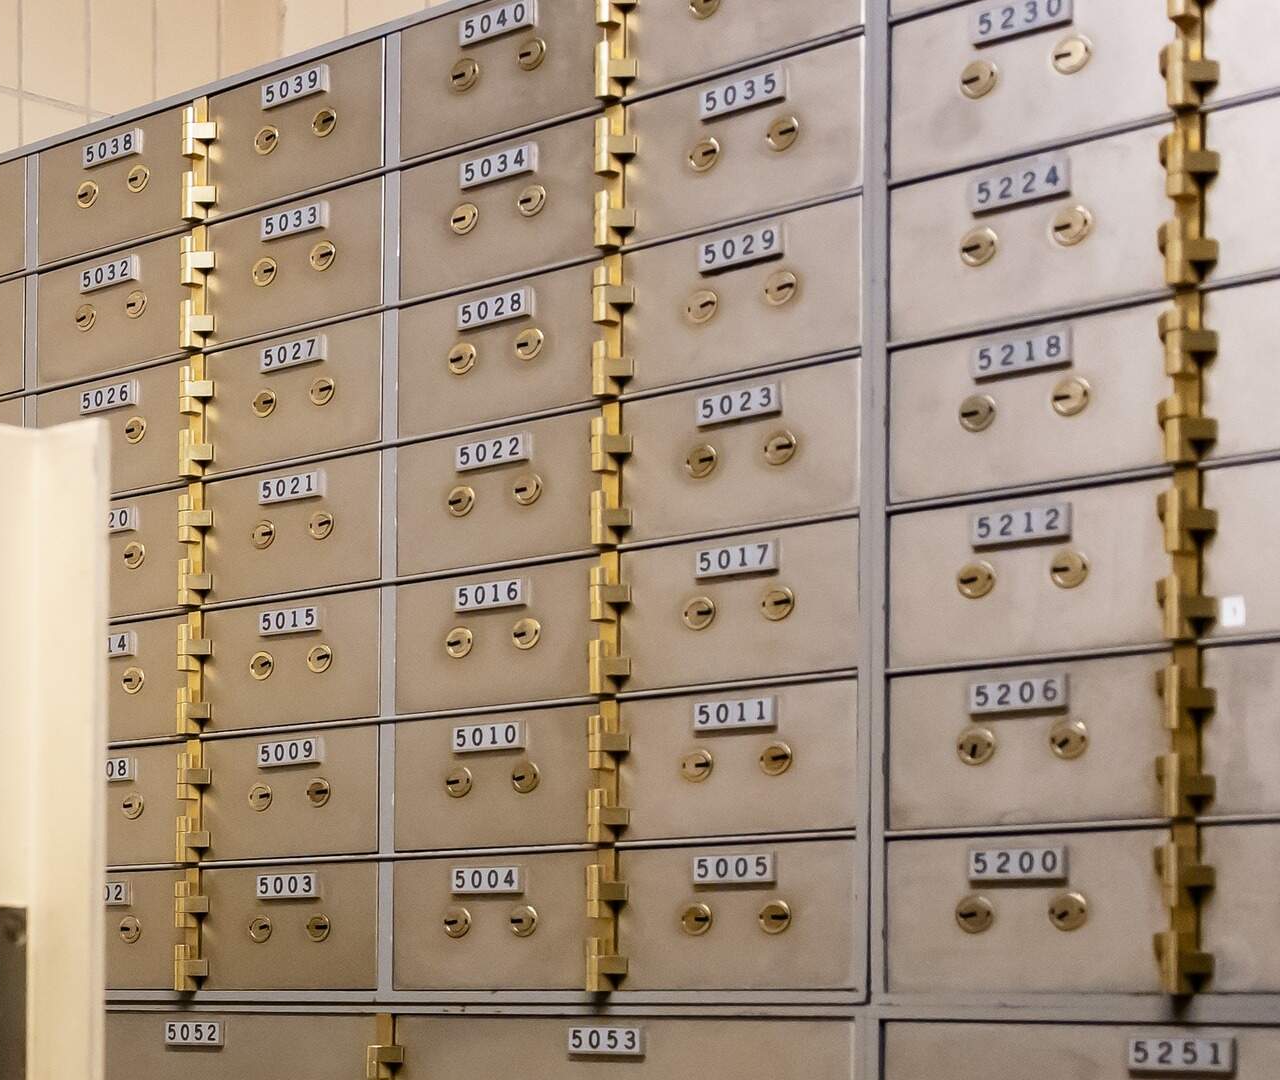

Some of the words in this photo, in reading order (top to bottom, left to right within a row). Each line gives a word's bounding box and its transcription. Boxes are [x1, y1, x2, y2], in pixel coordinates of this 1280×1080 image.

[465, 3, 525, 38] 5040
[979, 0, 1061, 34] 5230
[265, 70, 318, 102] 5039
[705, 73, 776, 110] 5035
[86, 133, 133, 161] 5038
[465, 149, 525, 181] 5034
[977, 165, 1060, 203] 5224
[265, 206, 317, 235] 5033
[704, 230, 774, 263] 5029
[83, 260, 129, 287] 5032
[461, 293, 521, 324] 5028
[264, 339, 316, 366] 5027
[978, 335, 1061, 370] 5218
[82, 383, 129, 409] 5026
[702, 386, 771, 419] 5023
[459, 437, 519, 465] 5022
[262, 475, 313, 498] 5021
[108, 510, 127, 528] 20
[978, 508, 1060, 538] 5212
[700, 543, 768, 572] 5017
[459, 581, 518, 606] 5016
[262, 608, 314, 630] 5015
[108, 635, 126, 652] 14
[975, 679, 1057, 706] 5206
[698, 701, 766, 724] 5011
[456, 724, 516, 747] 5010
[261, 740, 313, 762] 5009
[106, 760, 126, 776] 08
[696, 855, 768, 878] 5005
[973, 849, 1057, 874] 5200
[105, 884, 122, 900] 02
[259, 875, 312, 894] 5003
[455, 870, 514, 889] 5004
[168, 1024, 216, 1041] 5052
[572, 1029, 636, 1049] 5053
[1134, 1041, 1221, 1065] 5251
